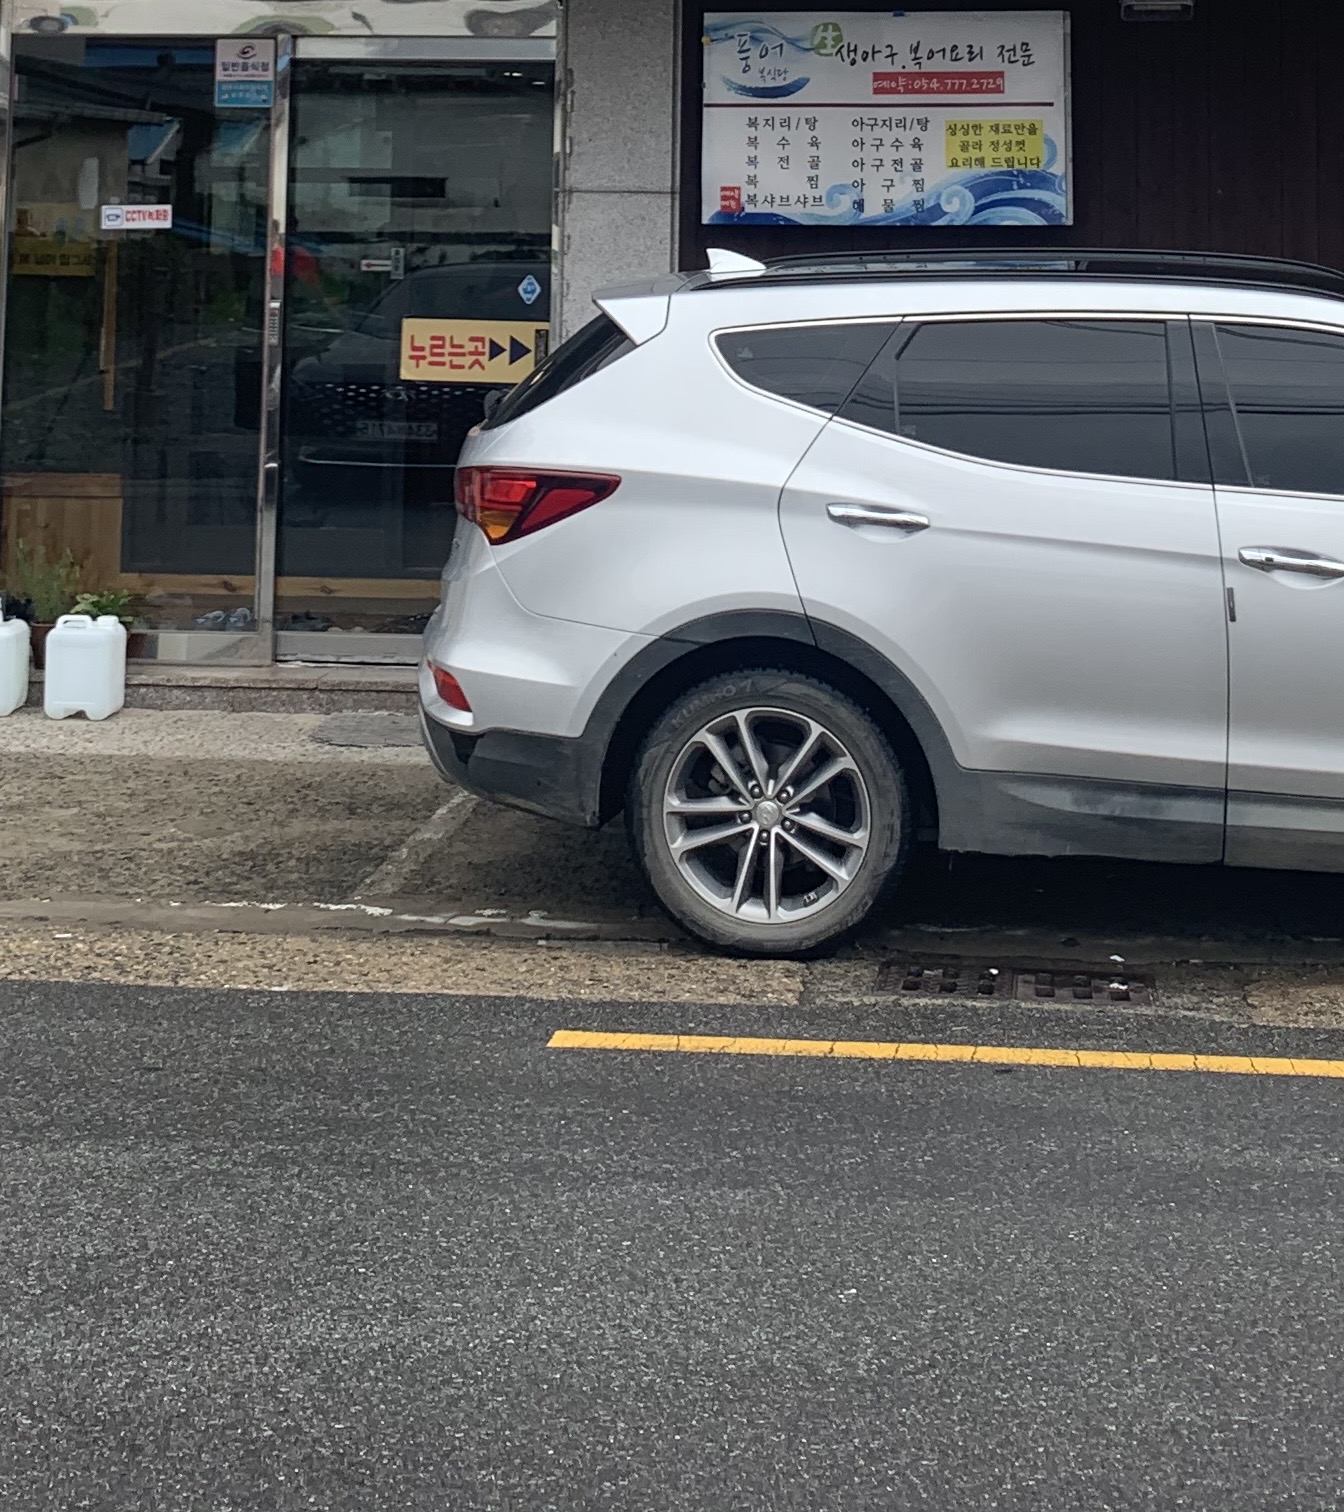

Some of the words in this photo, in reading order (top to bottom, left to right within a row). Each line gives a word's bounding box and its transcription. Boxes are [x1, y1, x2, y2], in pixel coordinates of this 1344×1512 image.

[996, 41, 1036, 67] 전문
[758, 67, 789, 82] 복식당
[851, 116, 930, 132] 아구지리/탕
[946, 123, 984, 136] 싱싱한
[988, 122, 1039, 136] 재료만을
[990, 156, 1042, 169] 드립니다
[408, 334, 487, 371] 누르는곳
